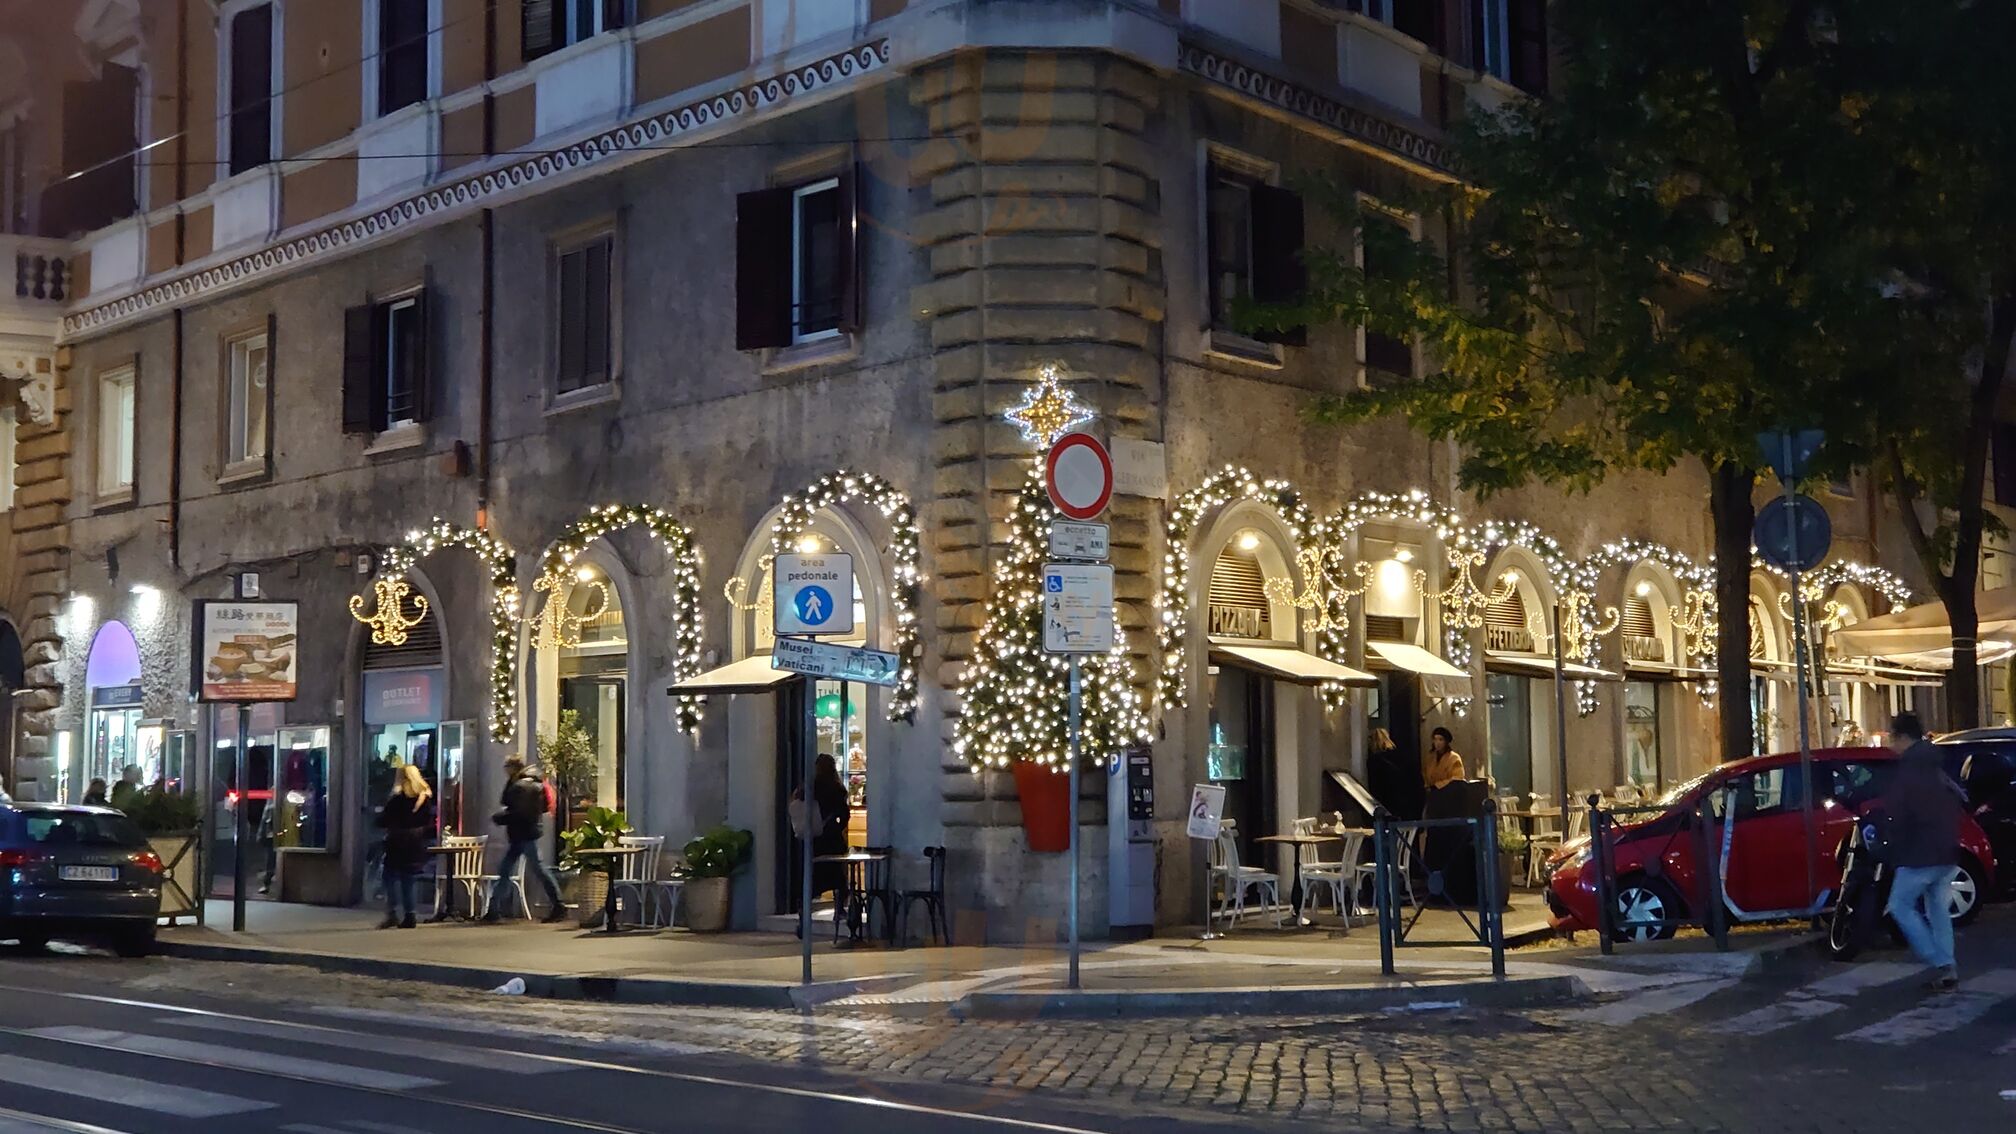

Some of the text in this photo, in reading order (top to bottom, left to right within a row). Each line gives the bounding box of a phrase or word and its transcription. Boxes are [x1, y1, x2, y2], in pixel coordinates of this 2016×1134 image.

[1064, 526, 1096, 535] eccetto
[800, 558, 825, 567] area
[788, 571, 838, 582] pedonale
[779, 641, 813, 655] Musei
[778, 658, 824, 673] Vaticani
[382, 686, 421, 700] OUTLET
[1110, 753, 1119, 773] P
